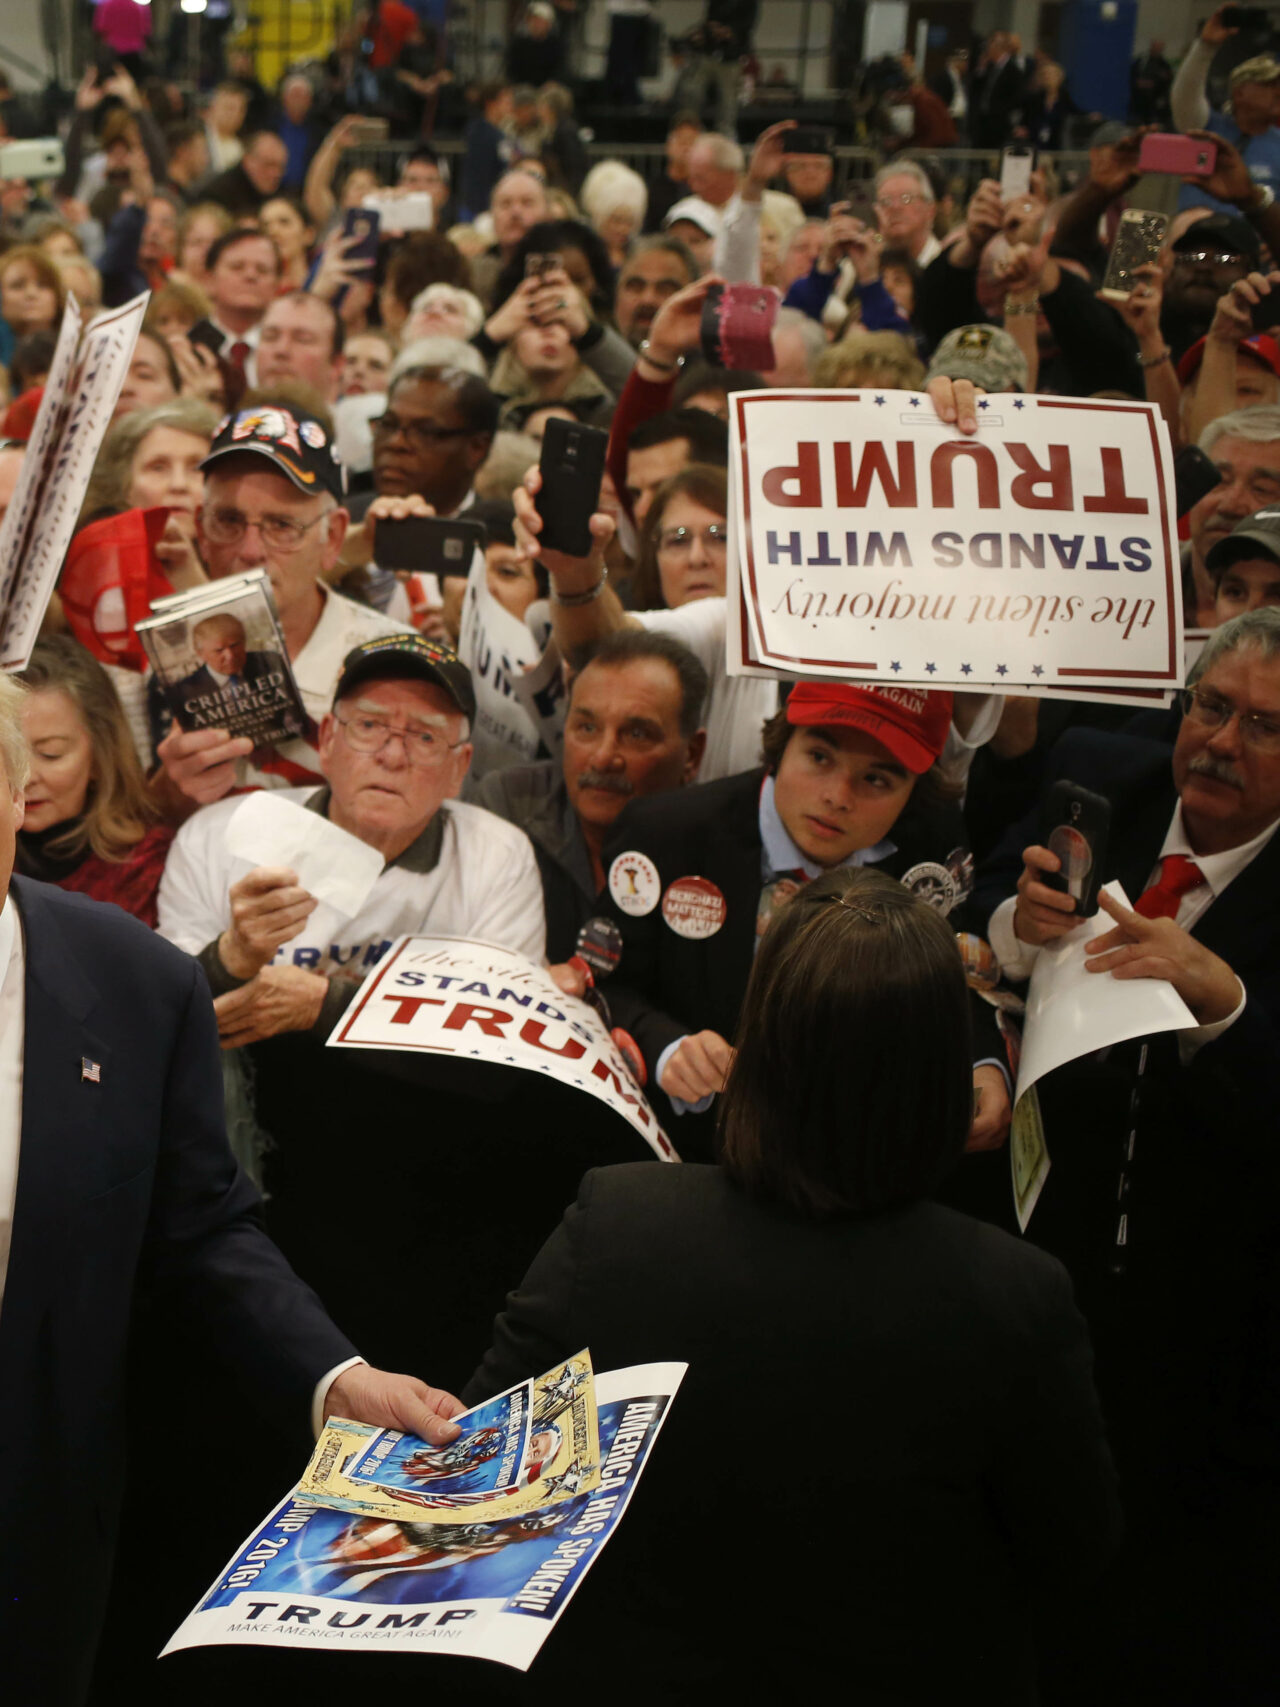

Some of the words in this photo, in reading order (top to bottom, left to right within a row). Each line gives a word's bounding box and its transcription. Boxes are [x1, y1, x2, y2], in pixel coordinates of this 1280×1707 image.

[761, 440, 1150, 515] TRUMP
[766, 530, 913, 568] WITH
[931, 531, 1153, 573] STANDS
[771, 578, 956, 632] majority
[966, 594, 1084, 638] silent
[1090, 596, 1156, 640] the
[184, 671, 284, 714] CRIPPLED
[195, 686, 288, 728] AMERICA
[877, 686, 926, 715] AGAIN
[271, 939, 393, 968] RUM
[394, 970, 596, 1044] STANDS
[508, 1391, 523, 1436] AMERICA
[371, 1440, 396, 1459] TRUMP
[504, 1433, 520, 1455] HAS
[593, 1401, 658, 1494] AMERICA
[570, 1495, 620, 1536] HAS
[221, 1537, 289, 1591] 2016!
[509, 1537, 594, 1612] SPOKEN!
[226, 1622, 276, 1633] MAKE
[271, 1624, 345, 1639] AMERICA
[349, 1629, 400, 1639] GREAT
[399, 1629, 463, 1639] AGAIN!
[245, 1602, 479, 1629] TRUMP
